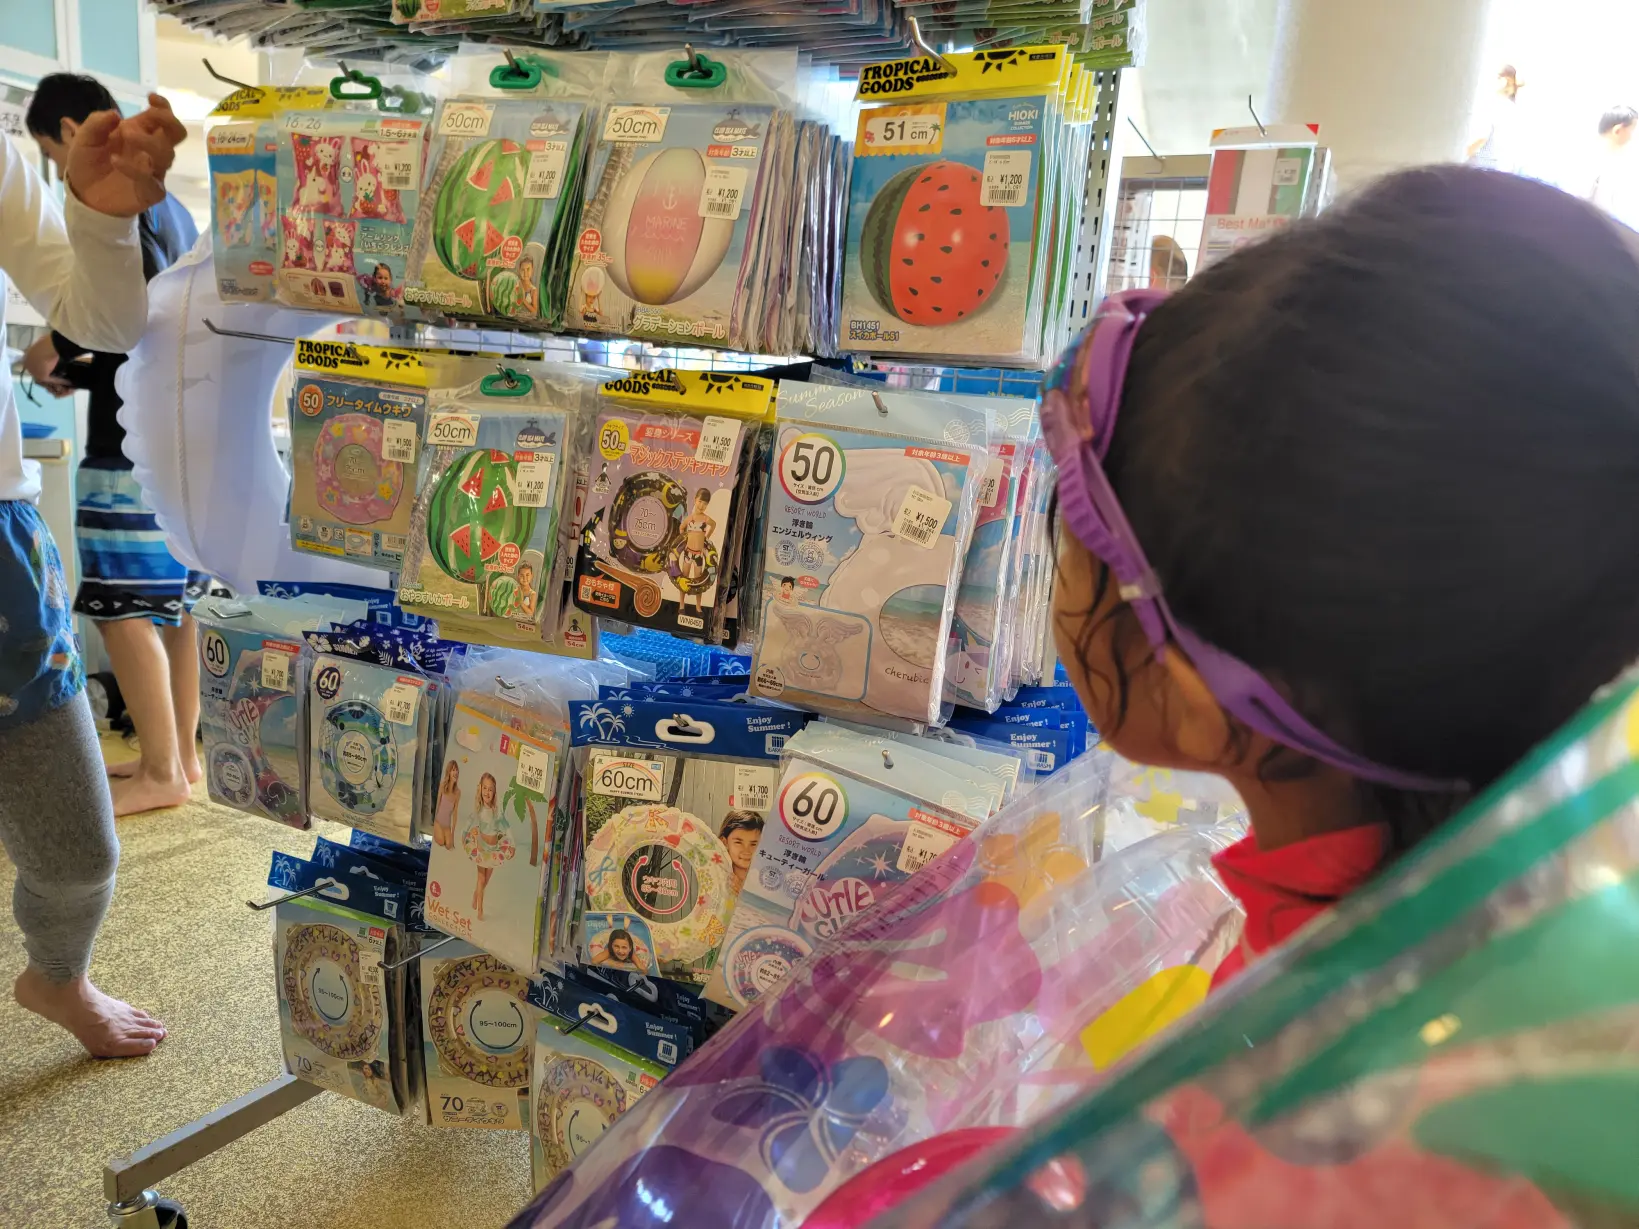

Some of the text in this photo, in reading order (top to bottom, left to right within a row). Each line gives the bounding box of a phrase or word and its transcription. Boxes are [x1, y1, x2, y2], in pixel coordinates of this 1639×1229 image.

[863, 59, 942, 81] TROPICAL
[859, 76, 914, 95] GOODS
[446, 113, 485, 129] 50cm
[1008, 109, 1038, 120] HIOKI
[612, 117, 657, 134] 50cm
[883, 121, 928, 142] 51 cm
[538, 171, 556, 180] ¥1,200
[1000, 174, 1022, 184] ¥1,200
[718, 188, 739, 199] ¥1,200
[645, 215, 689, 230] MARINE
[1217, 217, 1244, 230] Best
[632, 314, 726, 340] グラデーションボール
[850, 320, 880, 330] BH1451
[849, 331, 900, 341] スイカボール51
[298, 353, 339, 369] GOODS
[605, 380, 650, 394] GOODS
[303, 393, 319, 409] 50
[327, 395, 412, 418] フリータイムウキワ
[434, 423, 471, 440] 50cm
[602, 430, 620, 448] 50
[645, 427, 695, 442] 変身シリーズ
[713, 436, 731, 447] ¥1,500
[790, 442, 835, 485] 50
[527, 480, 544, 490] ¥1,200
[784, 505, 827, 520] RESORT WORLD
[916, 512, 938, 529] ¥1,500
[772, 526, 833, 543] エンジェルウィング
[401, 588, 470, 609] おやつすいかボール
[517, 623, 535, 632] 54cm
[206, 637, 225, 665] 60
[567, 640, 585, 649] 54cm
[319, 669, 339, 691] 60
[884, 666, 930, 685] cherubic
[746, 716, 773, 726] Enjoy
[1005, 714, 1031, 723] Enjoy
[747, 723, 785, 732] Summer
[1010, 733, 1038, 742] Enjoy
[601, 769, 653, 792] 60cm
[749, 785, 769, 795] ¥1,700
[793, 780, 839, 826] 60
[778, 834, 822, 857] RESORT WORLD
[758, 849, 826, 882] キューティーガール
[801, 879, 875, 924] CUTIE
[427, 896, 472, 932] Wet Set
[427, 911, 473, 940] COLLECTION
[479, 1020, 518, 1029] 95~100cm
[645, 1022, 664, 1032] Enjoy
[646, 1029, 674, 1039] Summer
[440, 1096, 464, 1112] 70
